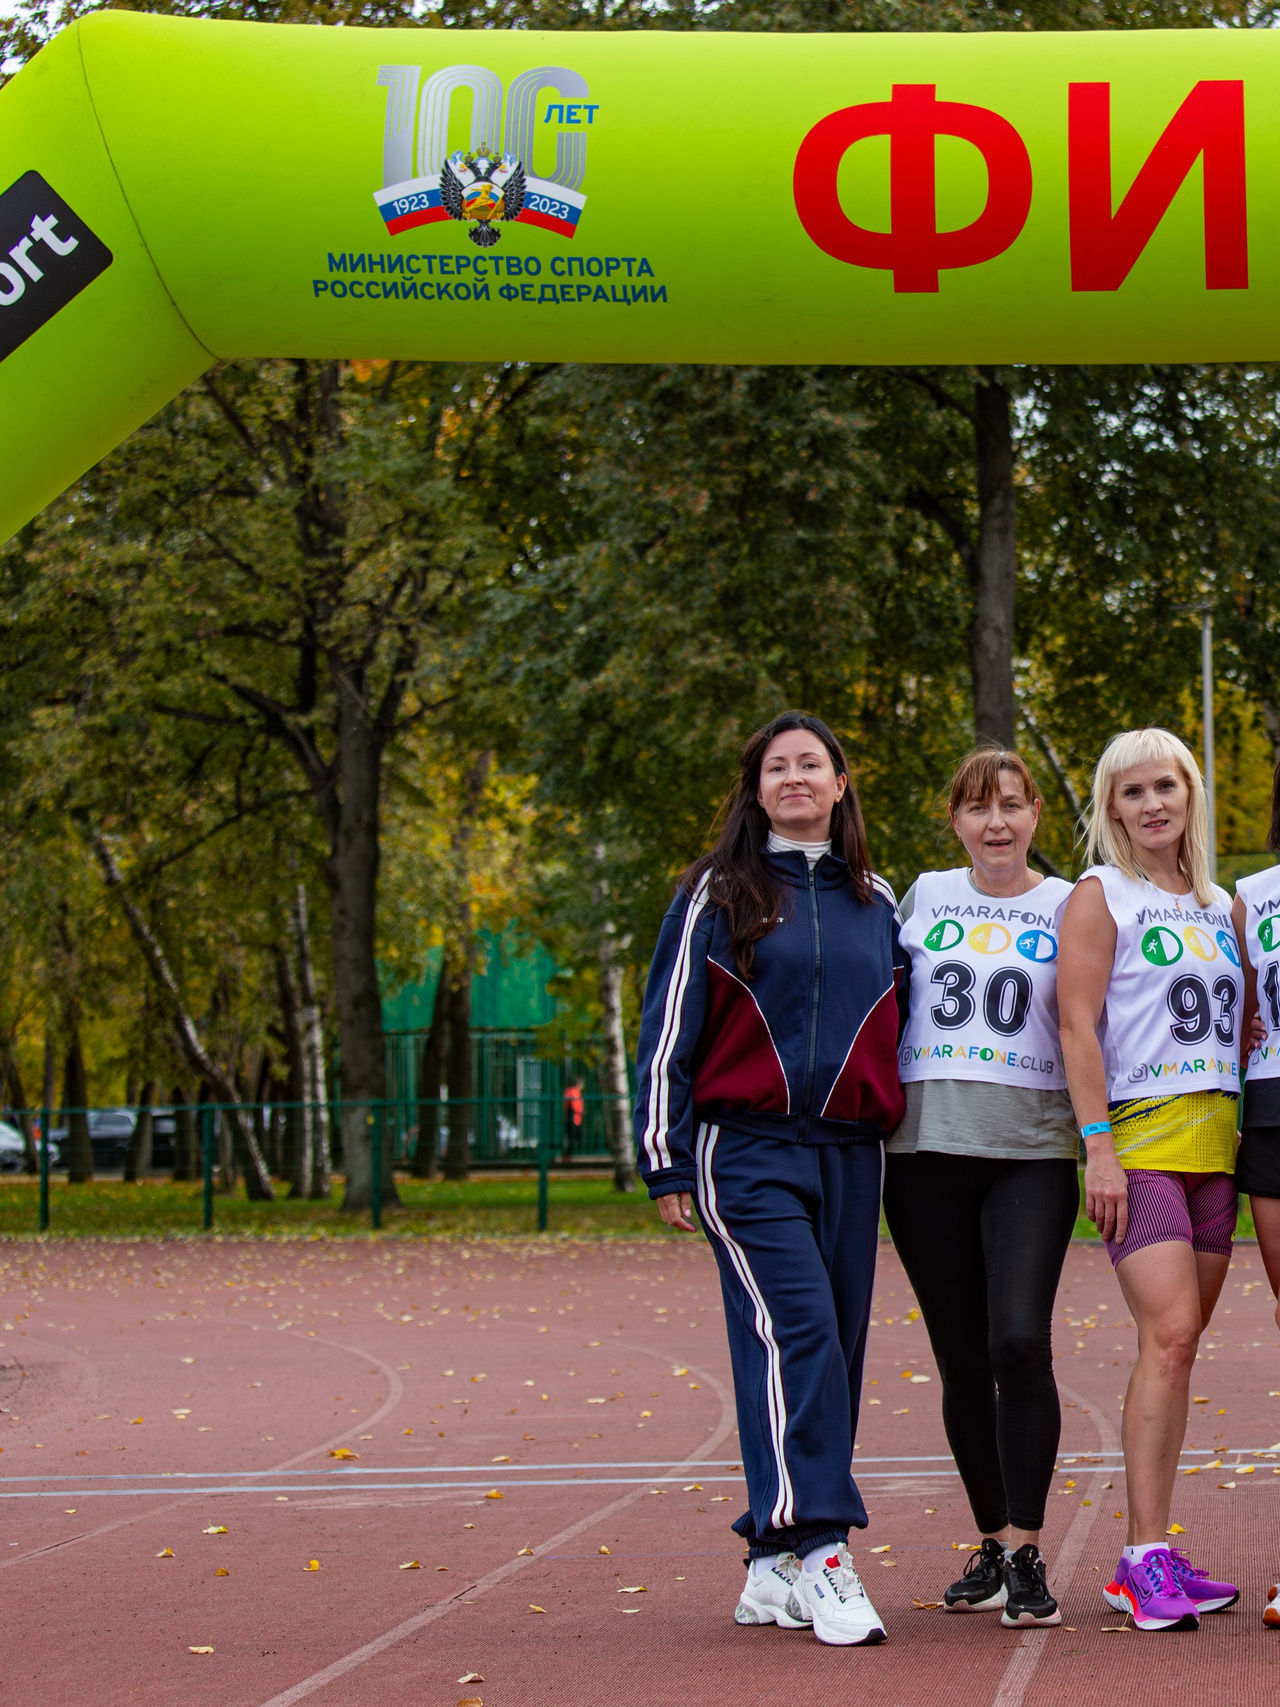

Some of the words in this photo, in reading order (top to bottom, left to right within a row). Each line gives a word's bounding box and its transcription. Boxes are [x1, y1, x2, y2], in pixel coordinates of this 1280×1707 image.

[544, 104, 600, 124] ЛЕТ
[392, 193, 429, 216] 1923
[528, 195, 570, 219] 2023
[327, 252, 541, 276] МИНИСТЕРСТВО
[550, 256, 655, 278] СПОРТА
[312, 276, 490, 300] РОССИЙСКОЙ
[498, 283, 668, 306] ФЕДЕРАЦИИ
[931, 904, 1055, 930] VMARAFON
[1135, 906, 1231, 928] VMARAFONE
[930, 959, 1033, 1038] 30
[1167, 973, 1238, 1048] 93
[1149, 1057, 1237, 1077] VMARAONE
